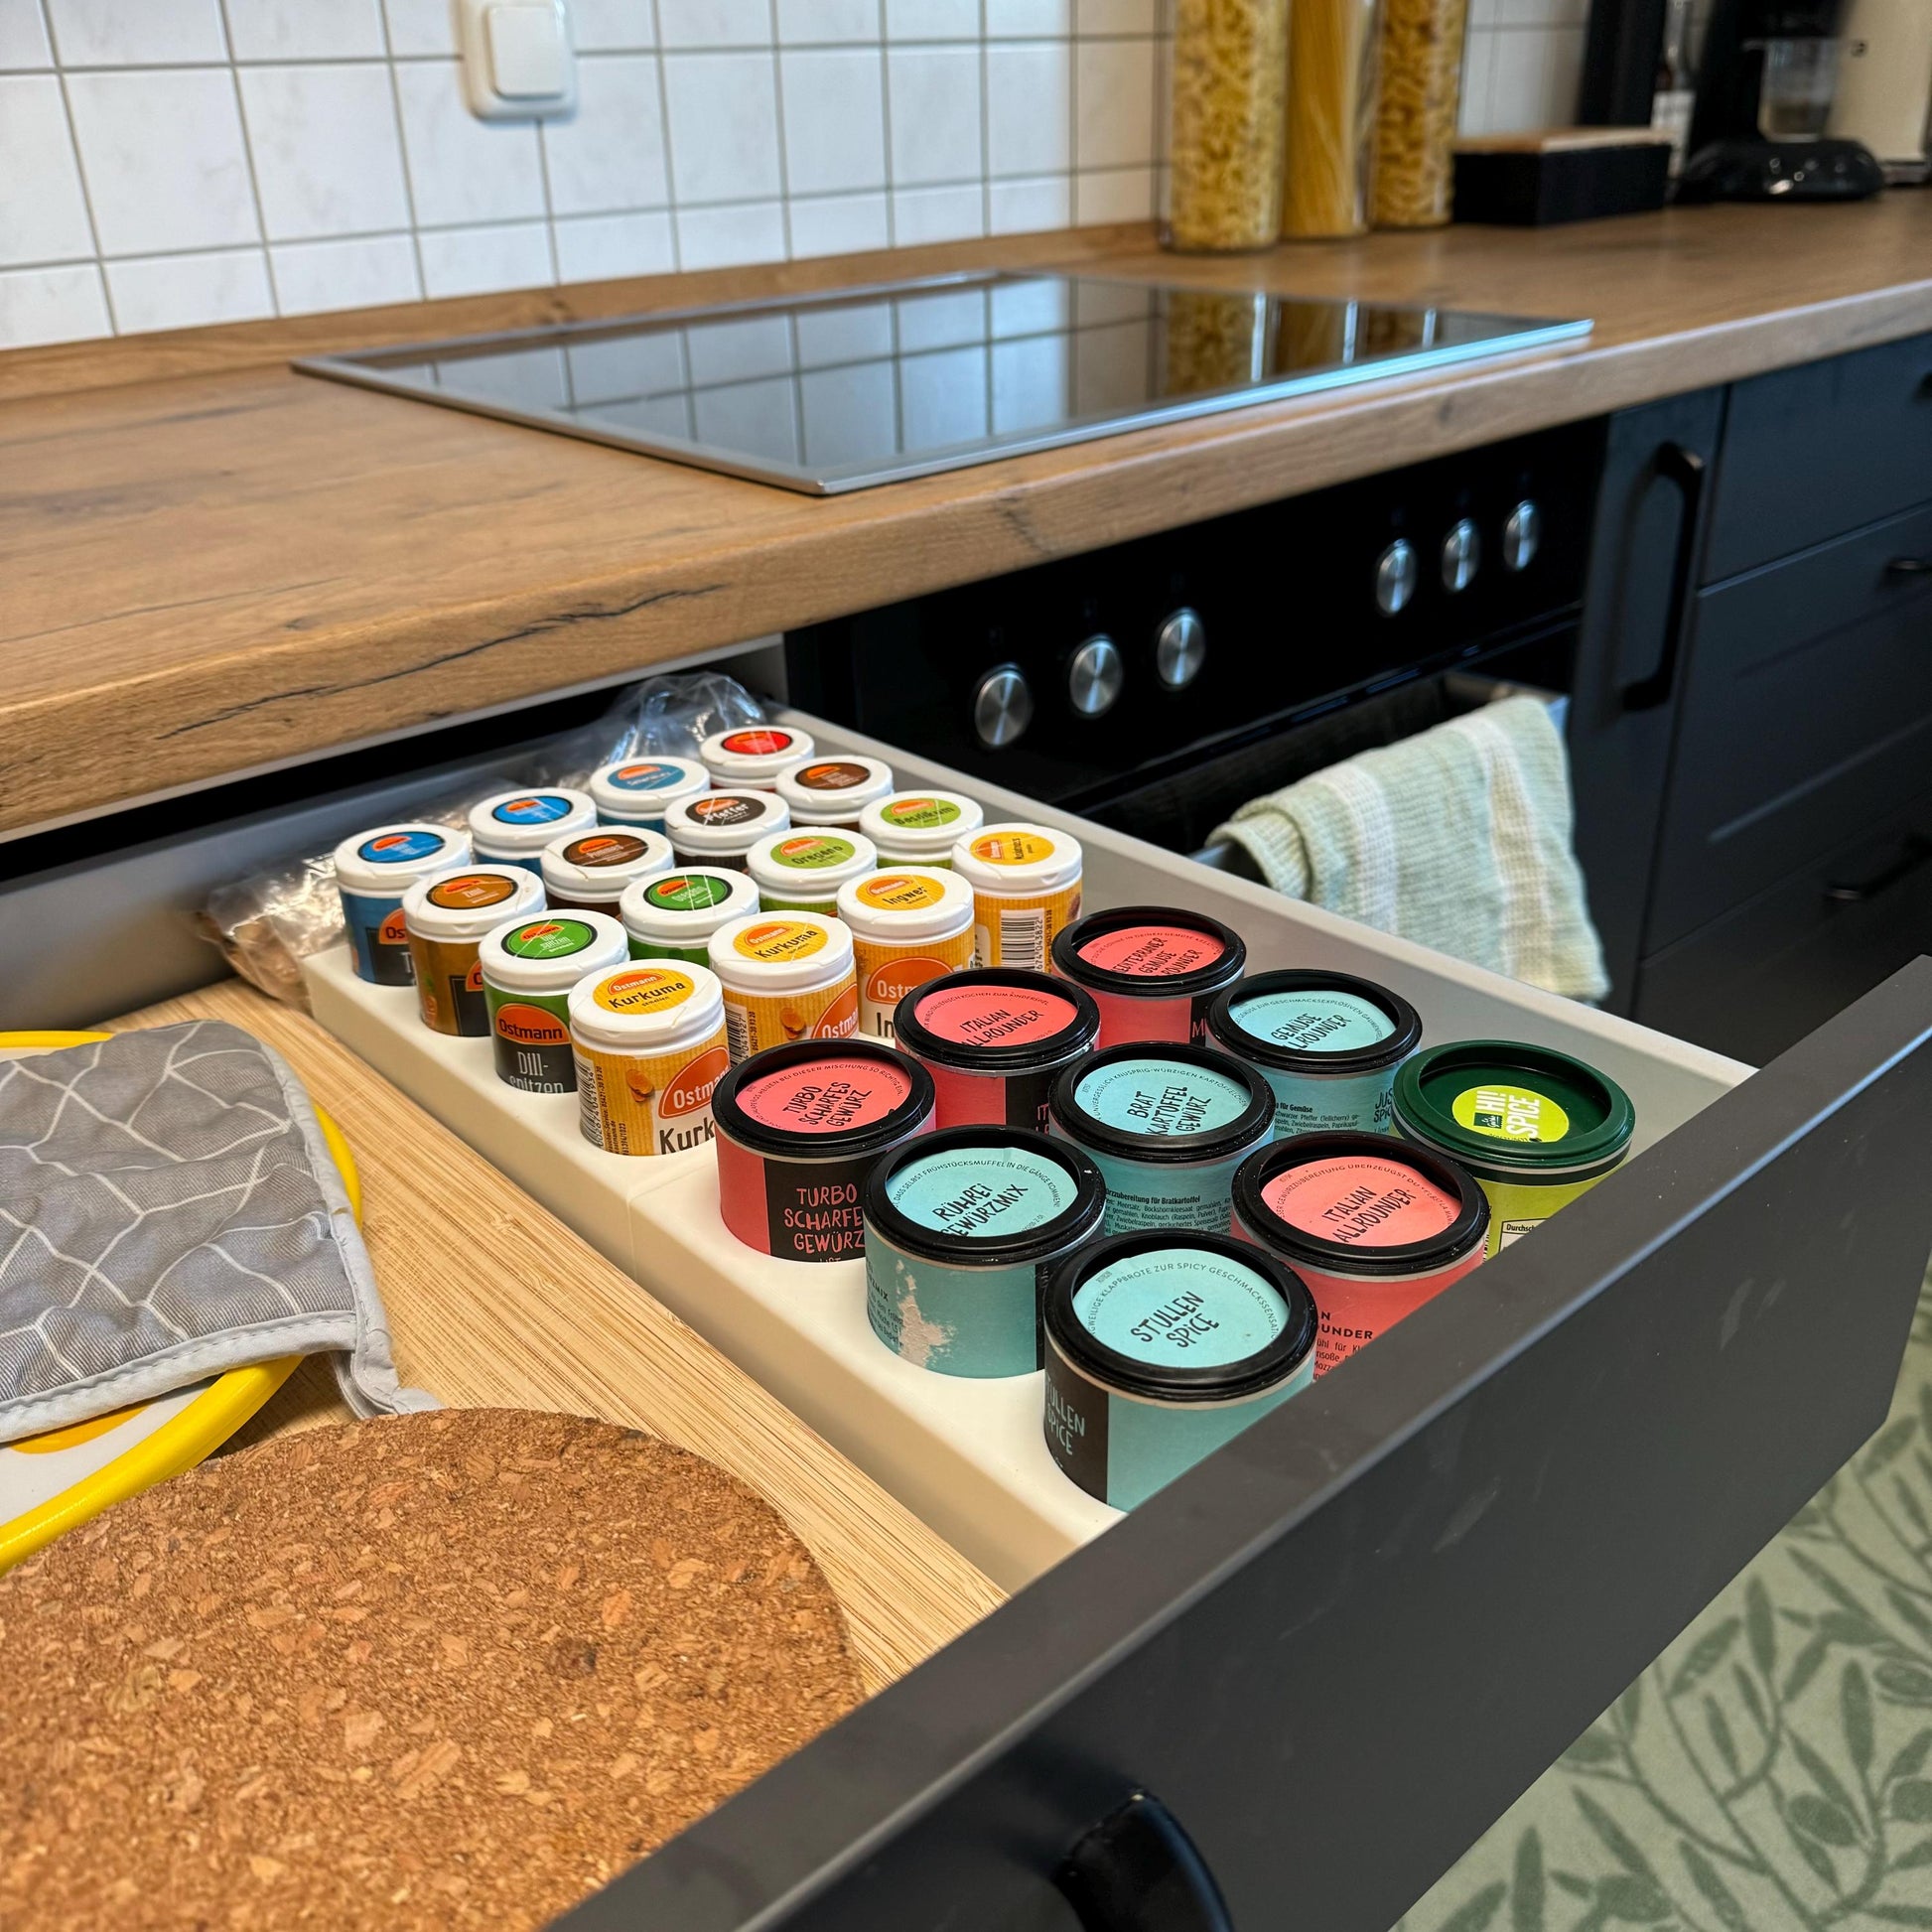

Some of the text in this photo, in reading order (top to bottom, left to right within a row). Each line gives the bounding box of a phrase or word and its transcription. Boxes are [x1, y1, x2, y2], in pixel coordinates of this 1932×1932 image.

[882, 886, 928, 905] Ingwer
[755, 930, 818, 958] Kurkuma
[1111, 937, 1169, 973] EDITERRANER
[1159, 949, 1203, 975] ROUNDER
[609, 982, 686, 1009] Kurkuma
[614, 975, 657, 991] Ostmann
[498, 1019, 563, 1039] Ostmann
[961, 1009, 1045, 1046] LLROUNDER
[1271, 1013, 1322, 1040] GEMÜSE
[1282, 1014, 1352, 1049] LROUNDER
[517, 1051, 549, 1076] Dill-
[792, 1065, 822, 1077] DIESER
[782, 1086, 823, 1114] TURBO
[798, 1081, 851, 1125] SCHARFES
[826, 1089, 873, 1127] GEWÜRZ
[1127, 1090, 1157, 1119] BRAT
[1290, 1104, 1313, 1113] Gemüse
[1375, 1088, 1393, 1109] JUS
[1175, 1096, 1212, 1132] GEWÜRZ
[1276, 1111, 1299, 1120] chwarzer
[1505, 1094, 1541, 1140] SPICE
[659, 1117, 715, 1155] Kurk
[902, 1173, 924, 1189] SELBST
[922, 1160, 1005, 1175] FRÜHSTÜCKSMUFFEL
[1029, 1169, 1050, 1184] GÄNGE
[1347, 1164, 1407, 1178] ÜBERZEUGST
[1407, 1177, 1420, 1187] DU
[796, 1182, 858, 1207] TURBO
[932, 1182, 993, 1222] RÜHREI
[1162, 1195, 1200, 1204] Bratkartoffel
[784, 1206, 864, 1231] SCHARFE
[1332, 1188, 1417, 1243] ALLROUNDER
[794, 1229, 866, 1254] GEWÜRZ
[1088, 1297, 1104, 1334] GWEILIGE
[1101, 1267, 1152, 1297] KLAPPBROTE
[1154, 1263, 1173, 1272] ZUR
[1177, 1262, 1207, 1271] SPICY
[1131, 1291, 1204, 1342] STULLEN
[1166, 1312, 1220, 1348] SPICE
[1320, 1323, 1373, 1339] UNDER
[1334, 1341, 1346, 1351] für
[1045, 1372, 1085, 1437] TULLEN
